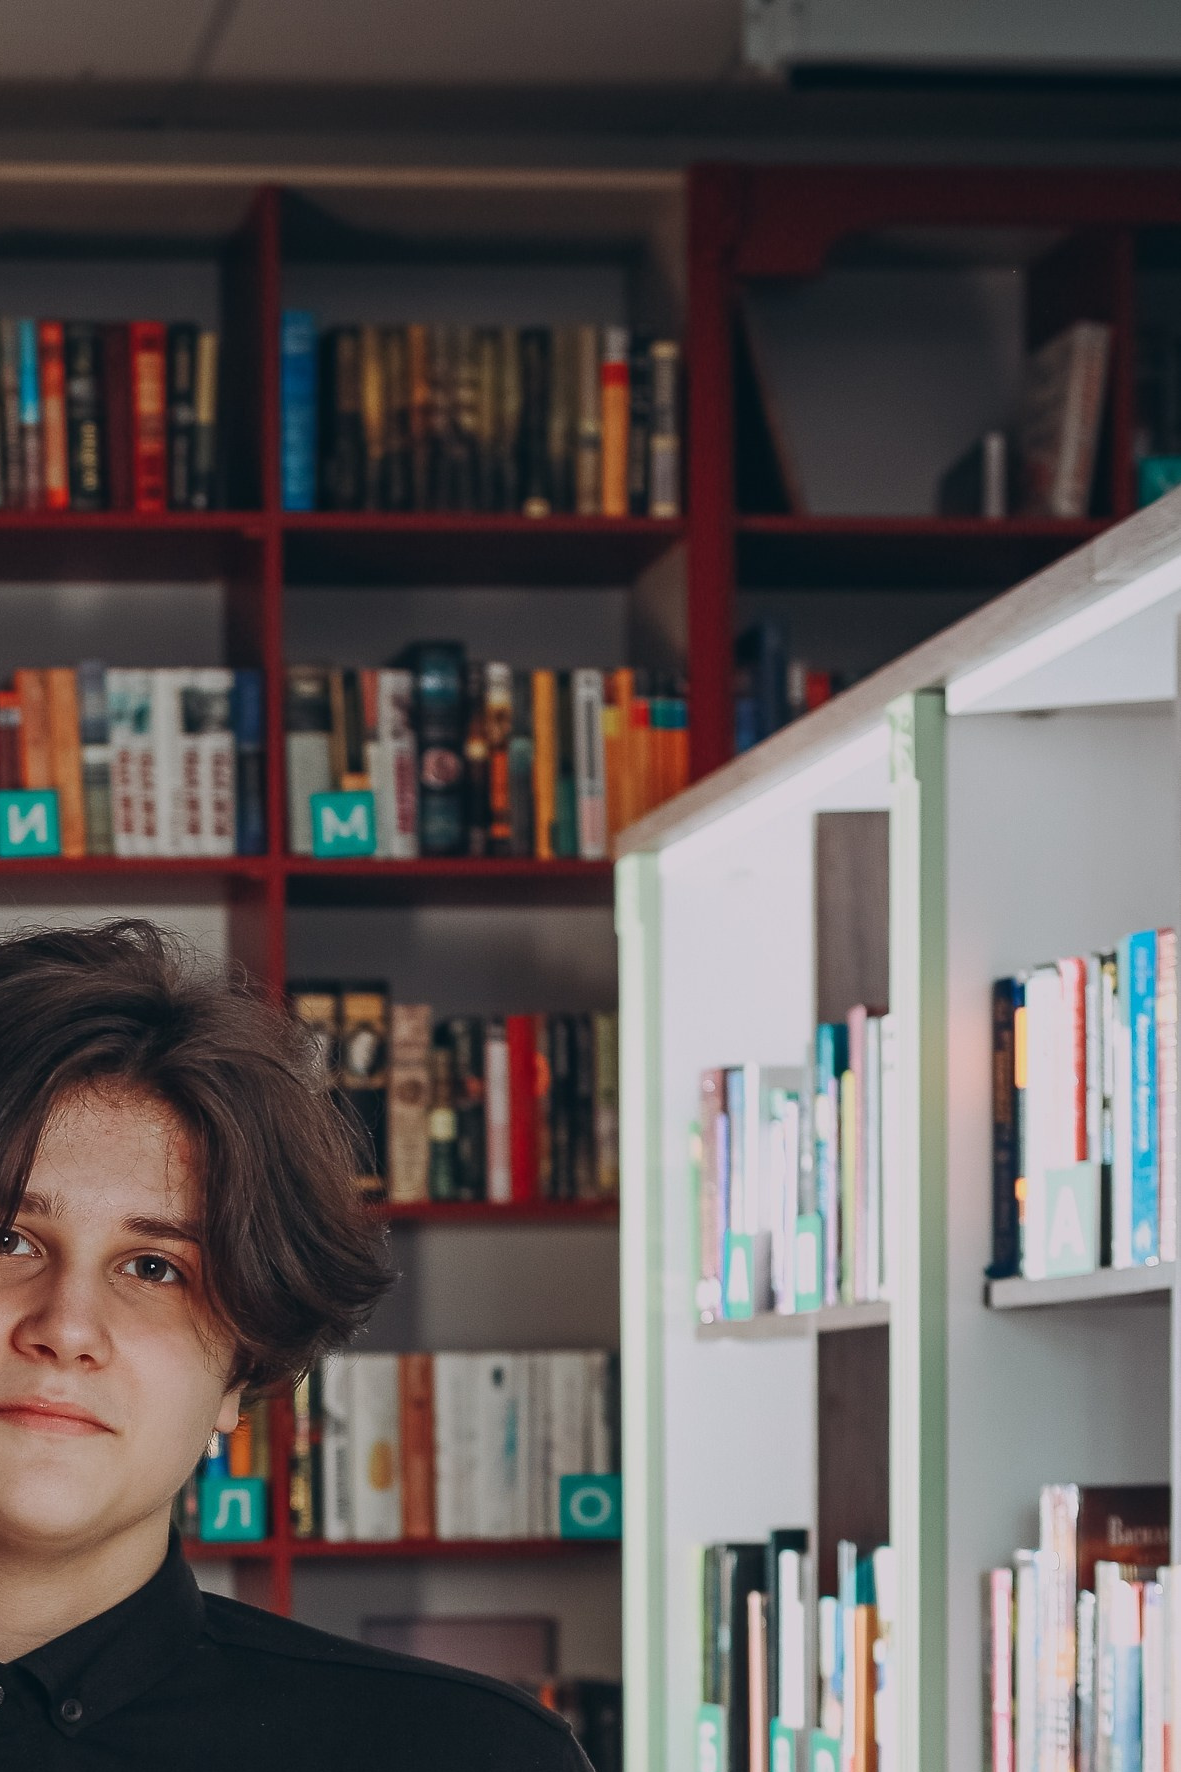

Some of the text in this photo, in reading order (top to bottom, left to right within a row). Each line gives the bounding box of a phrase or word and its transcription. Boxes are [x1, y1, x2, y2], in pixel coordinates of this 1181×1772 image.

[6, 804, 47, 845] И
[321, 806, 368, 844] М
[1047, 1185, 1086, 1258] А
[213, 1489, 253, 1531] Л
[570, 1486, 614, 1529] О
